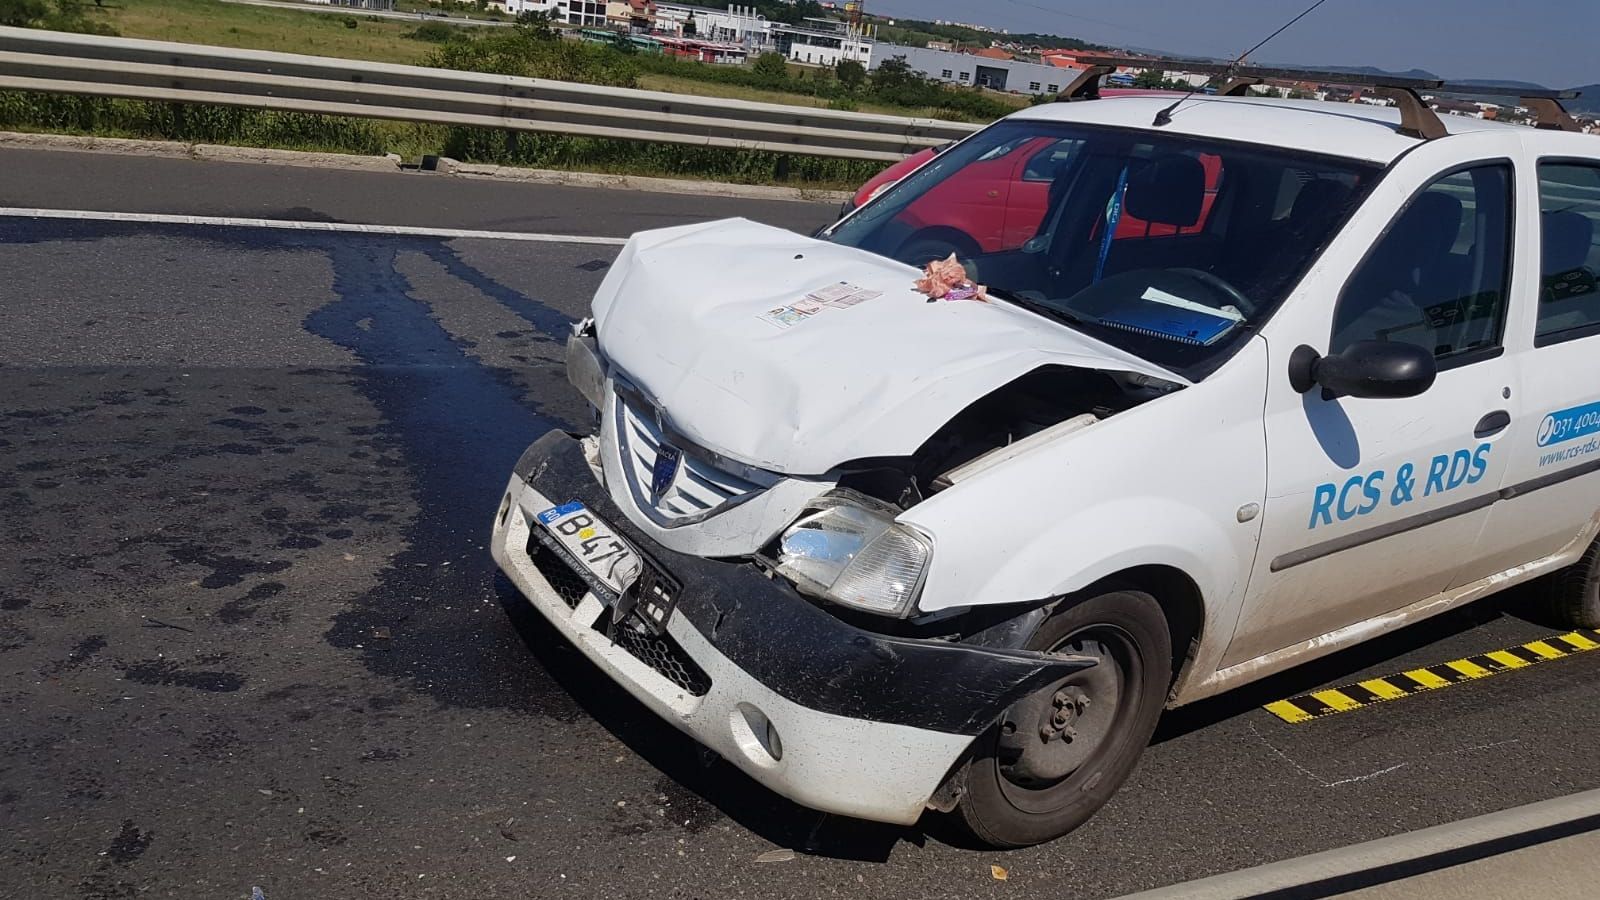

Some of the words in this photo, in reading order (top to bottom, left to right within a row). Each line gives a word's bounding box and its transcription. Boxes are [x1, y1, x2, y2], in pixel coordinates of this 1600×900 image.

[1553, 417, 1573, 438] 031
[1308, 470, 1384, 530] RCS
[1390, 462, 1415, 506] &
[1422, 442, 1491, 497] RDS
[544, 509, 561, 521] RO
[556, 514, 594, 536] B
